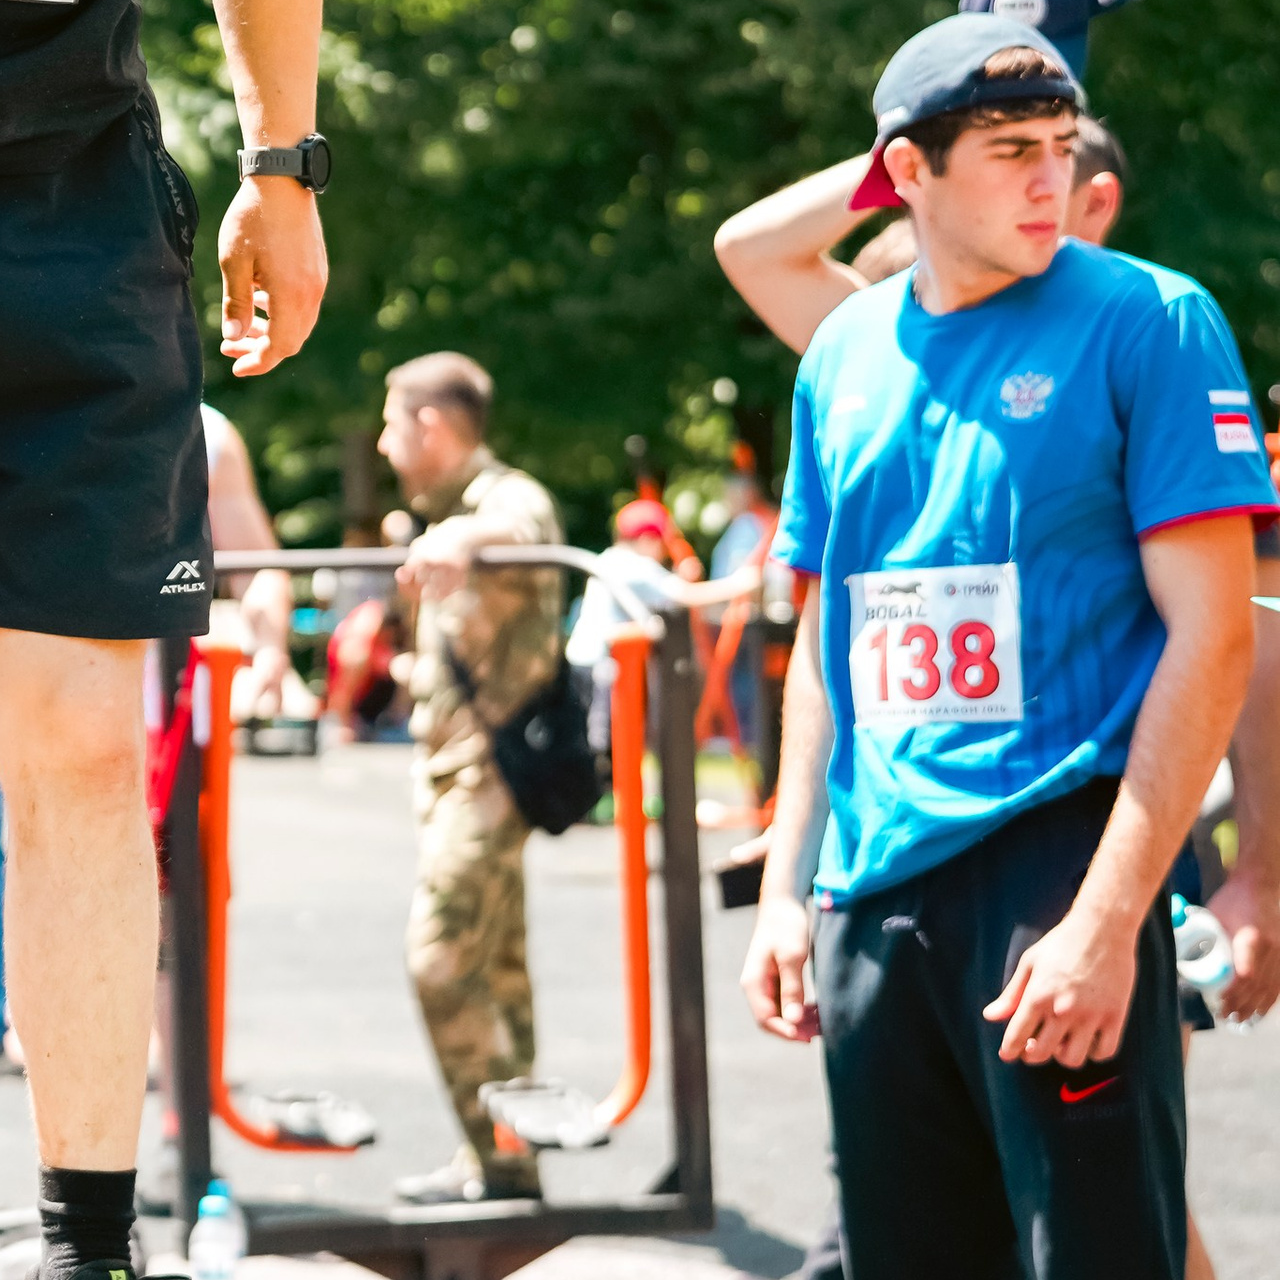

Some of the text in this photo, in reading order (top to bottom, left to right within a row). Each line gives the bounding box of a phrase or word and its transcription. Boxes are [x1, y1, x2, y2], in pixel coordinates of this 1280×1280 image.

[159, 582, 205, 594] ATHLEX
[864, 603, 928, 621] BOGAL
[869, 620, 1000, 702] 138
